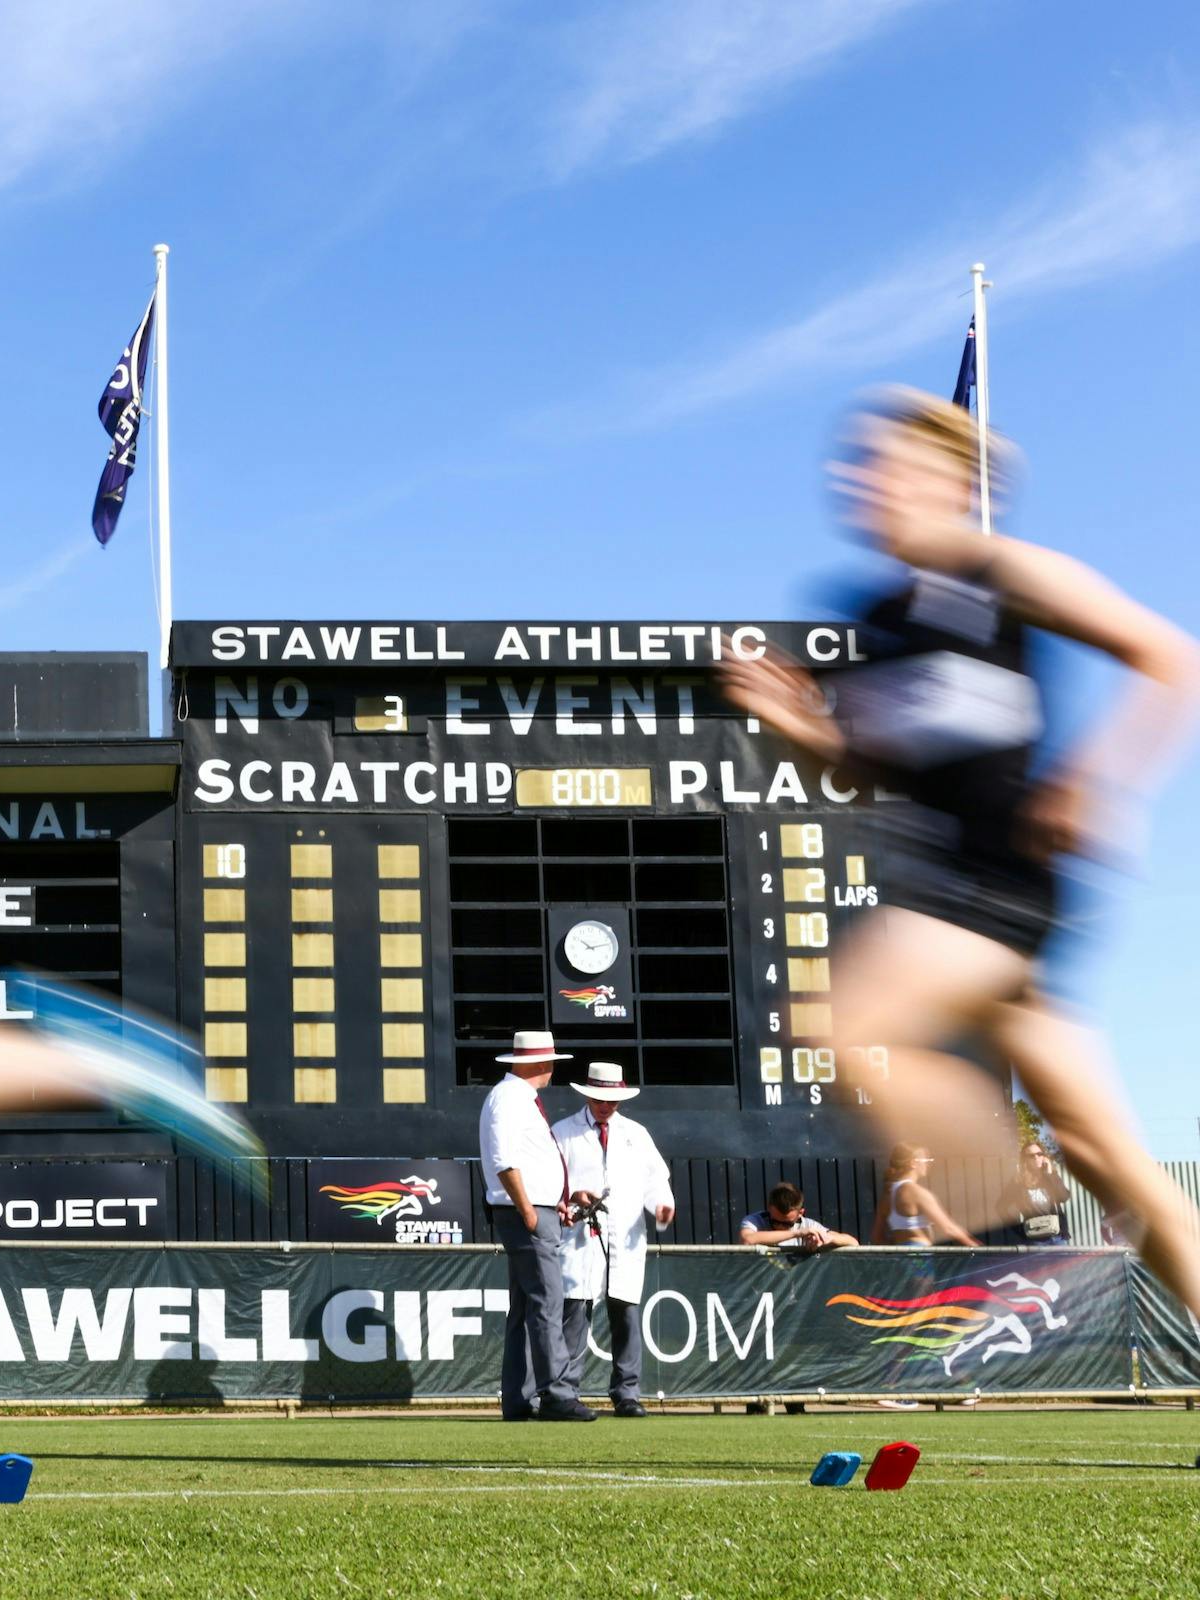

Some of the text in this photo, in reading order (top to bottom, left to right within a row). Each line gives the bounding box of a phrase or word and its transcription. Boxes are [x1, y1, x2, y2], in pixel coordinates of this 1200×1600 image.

[211, 626, 869, 662] STAWELL ATHLETIC CL
[384, 695, 404, 731] 3
[445, 676, 704, 735] EVENT
[669, 760, 912, 804] PLAC
[759, 824, 824, 858] 1 8
[217, 844, 246, 879] 10
[761, 868, 826, 902] 2 2
[834, 886, 878, 907] LAPS
[763, 912, 829, 948] 3 10
[766, 964, 777, 984] 4
[769, 1012, 780, 1032] 5
[760, 1047, 782, 1083] 2
[792, 1047, 836, 1083] 09
[765, 1084, 782, 1105] M
[810, 1084, 822, 1105] S
[395, 1220, 462, 1233] STAWELL
[395, 1232, 428, 1244] GIFT
